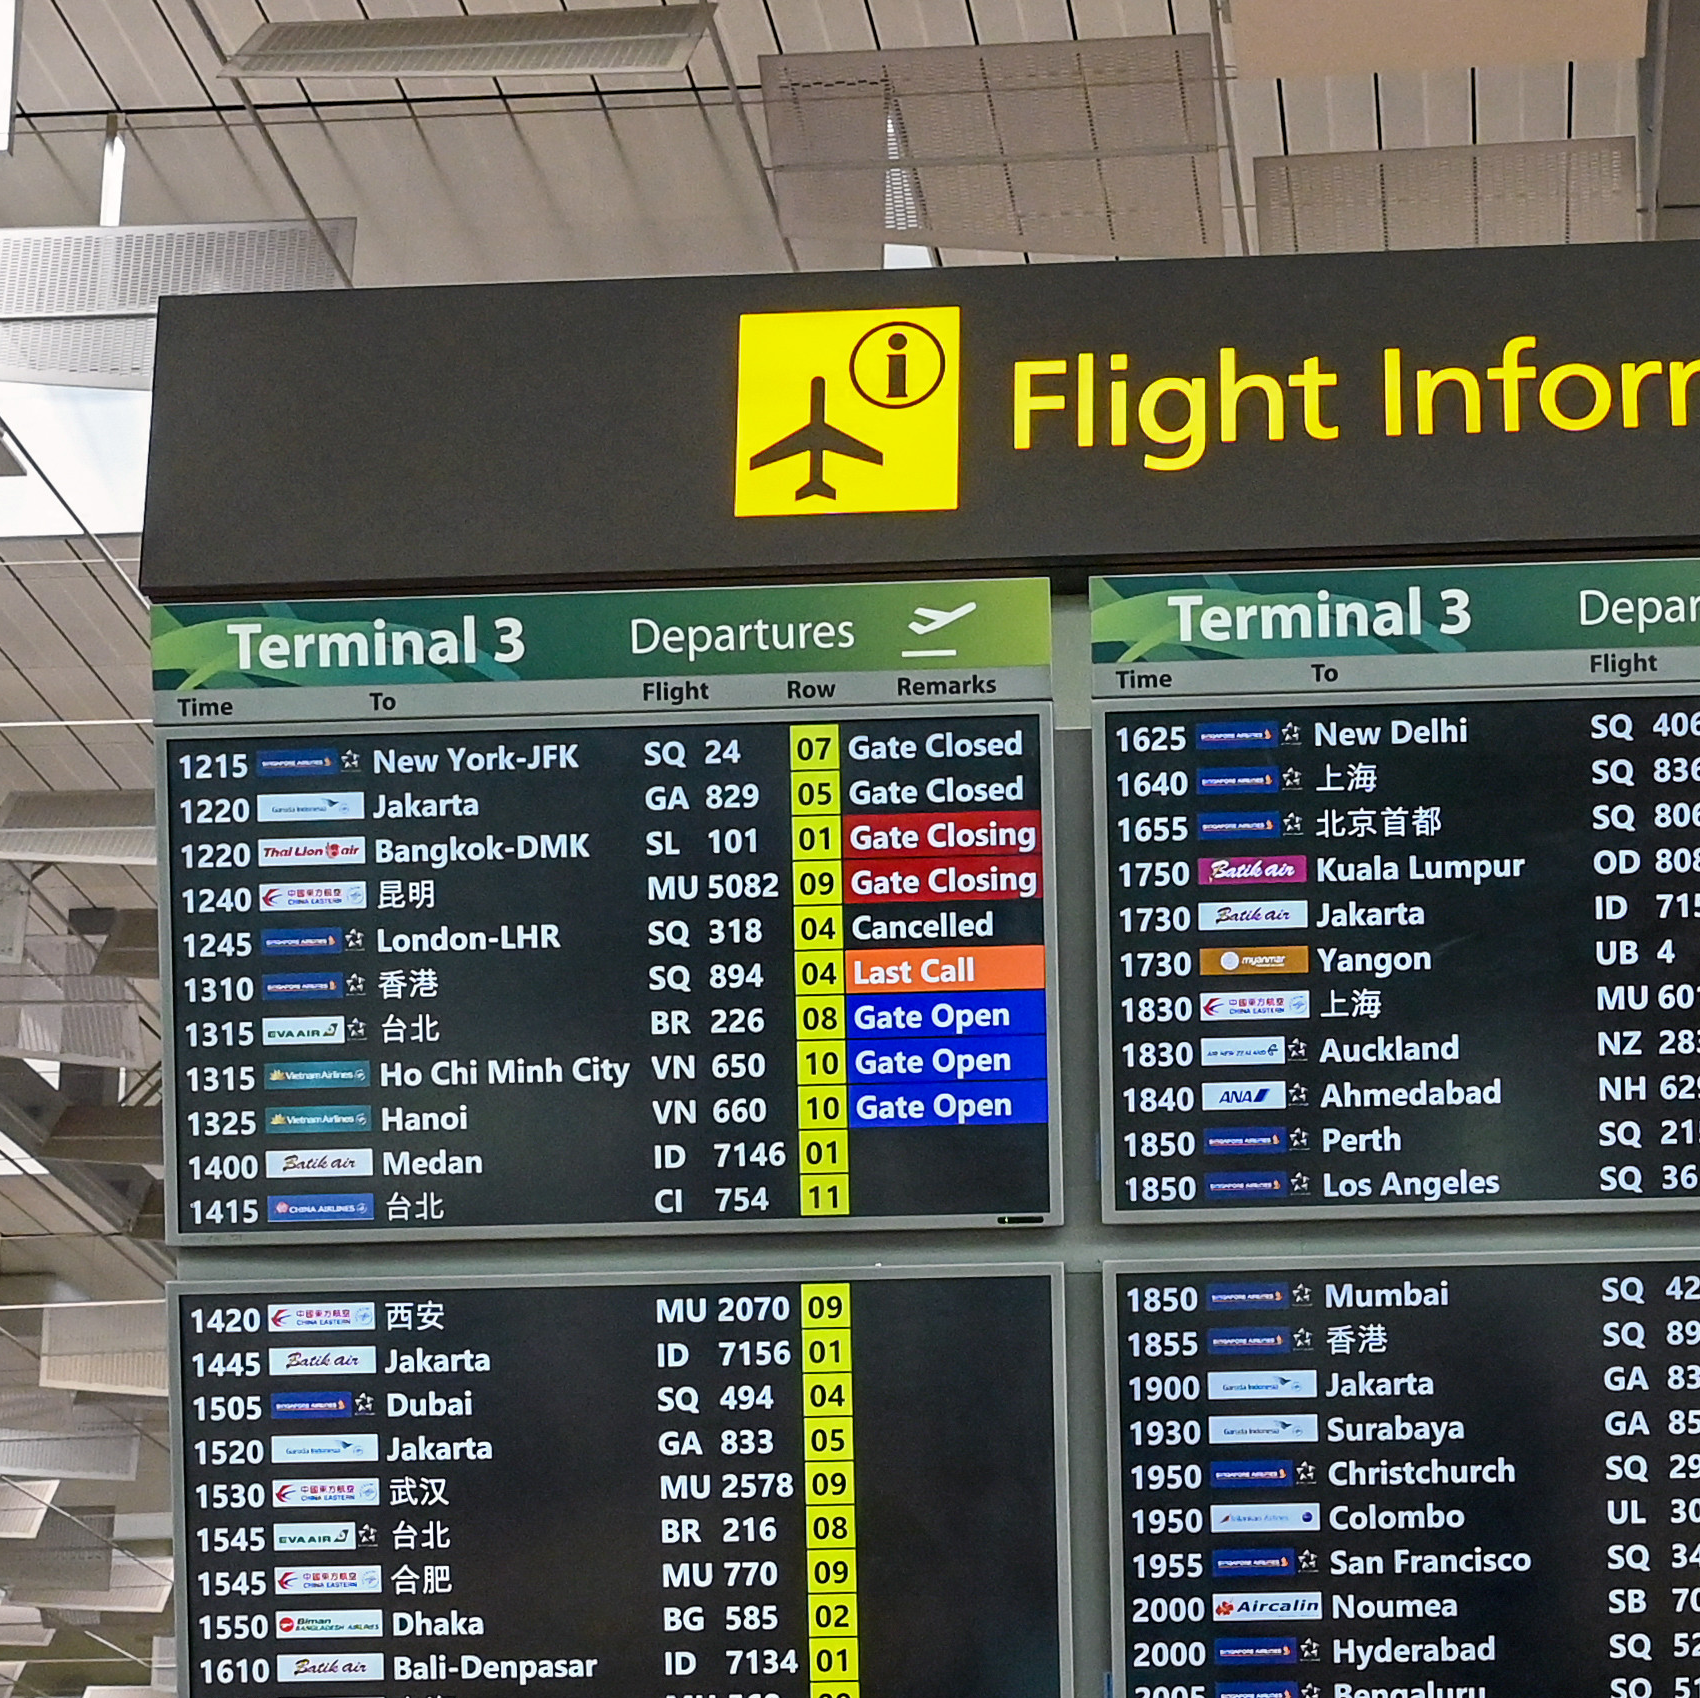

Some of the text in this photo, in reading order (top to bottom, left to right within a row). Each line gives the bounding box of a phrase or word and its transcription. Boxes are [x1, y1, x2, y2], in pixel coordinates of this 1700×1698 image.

[1013, 347, 1339, 471] Flight
[1167, 586, 1472, 642] Terminal 3
[226, 614, 525, 670] Terminal 3
[631, 618, 855, 662] Departures
[369, 692, 396, 712] To
[641, 680, 710, 706] Flight
[787, 680, 836, 699] Row
[895, 672, 997, 698] Remarks
[177, 697, 233, 717] Time
[181, 820, 1036, 870] 1220 Thai Lion air Bangkok-DMK SL 101 01 Gate Closing
[1118, 861, 1190, 888] 1750
[1208, 856, 1263, 885] Batik
[1263, 856, 1298, 884] air
[1316, 854, 1400, 883] Kuala
[1408, 854, 1526, 886] Lumpur
[1593, 849, 1641, 876] OD
[184, 956, 976, 1003] 1310 香港 SQ 894 04 Last Call
[1122, 1086, 1195, 1113] 1840
[1217, 1084, 1255, 1107] ANA
[1320, 1077, 1502, 1109] Ahmedabad
[1598, 1075, 1647, 1102] NH
[196, 1516, 848, 1553] 1545 EVA AIR 台北 BR 216 08
[1132, 1596, 1206, 1623] 2000
[1237, 1598, 1319, 1614] Aircalin
[1332, 1593, 1458, 1620] Noumea
[1608, 1588, 1647, 1614] SB
